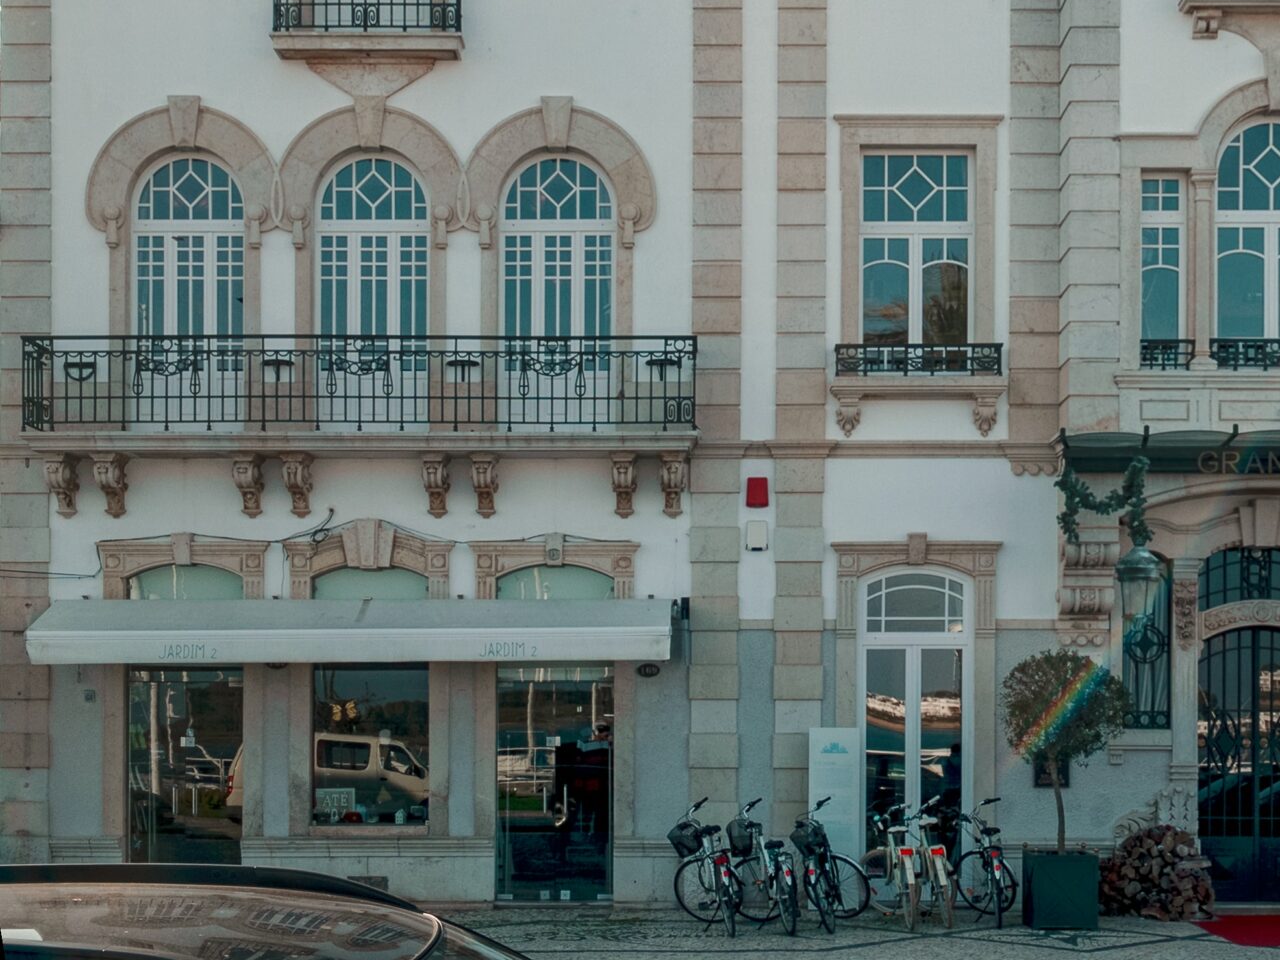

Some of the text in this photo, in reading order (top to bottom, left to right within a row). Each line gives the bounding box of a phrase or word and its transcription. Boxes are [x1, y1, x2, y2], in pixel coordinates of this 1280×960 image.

[159, 643, 217, 659] JARDIM 2
[479, 641, 538, 657] JARDIM 2
